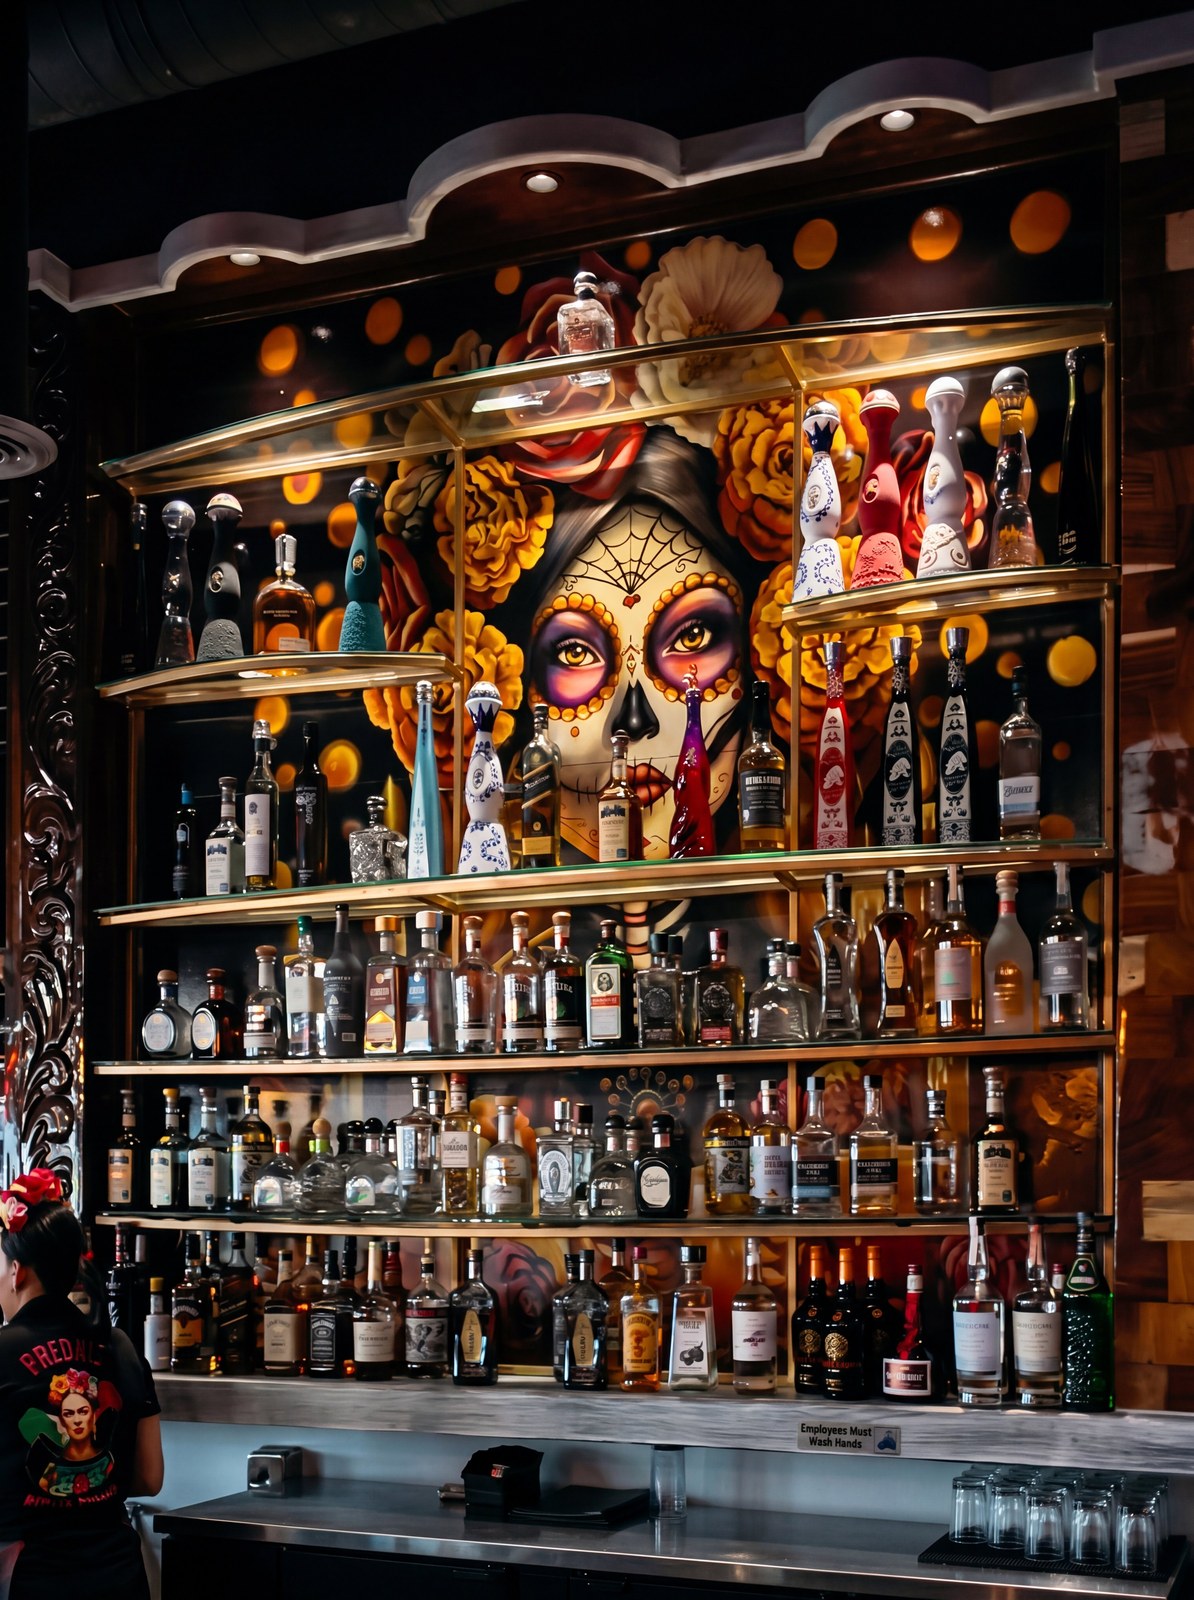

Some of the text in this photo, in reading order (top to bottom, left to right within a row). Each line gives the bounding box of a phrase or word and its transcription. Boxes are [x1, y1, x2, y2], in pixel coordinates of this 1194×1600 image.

[801, 1423, 872, 1437] Employees Must
[809, 1436, 862, 1448] Wash Hands
